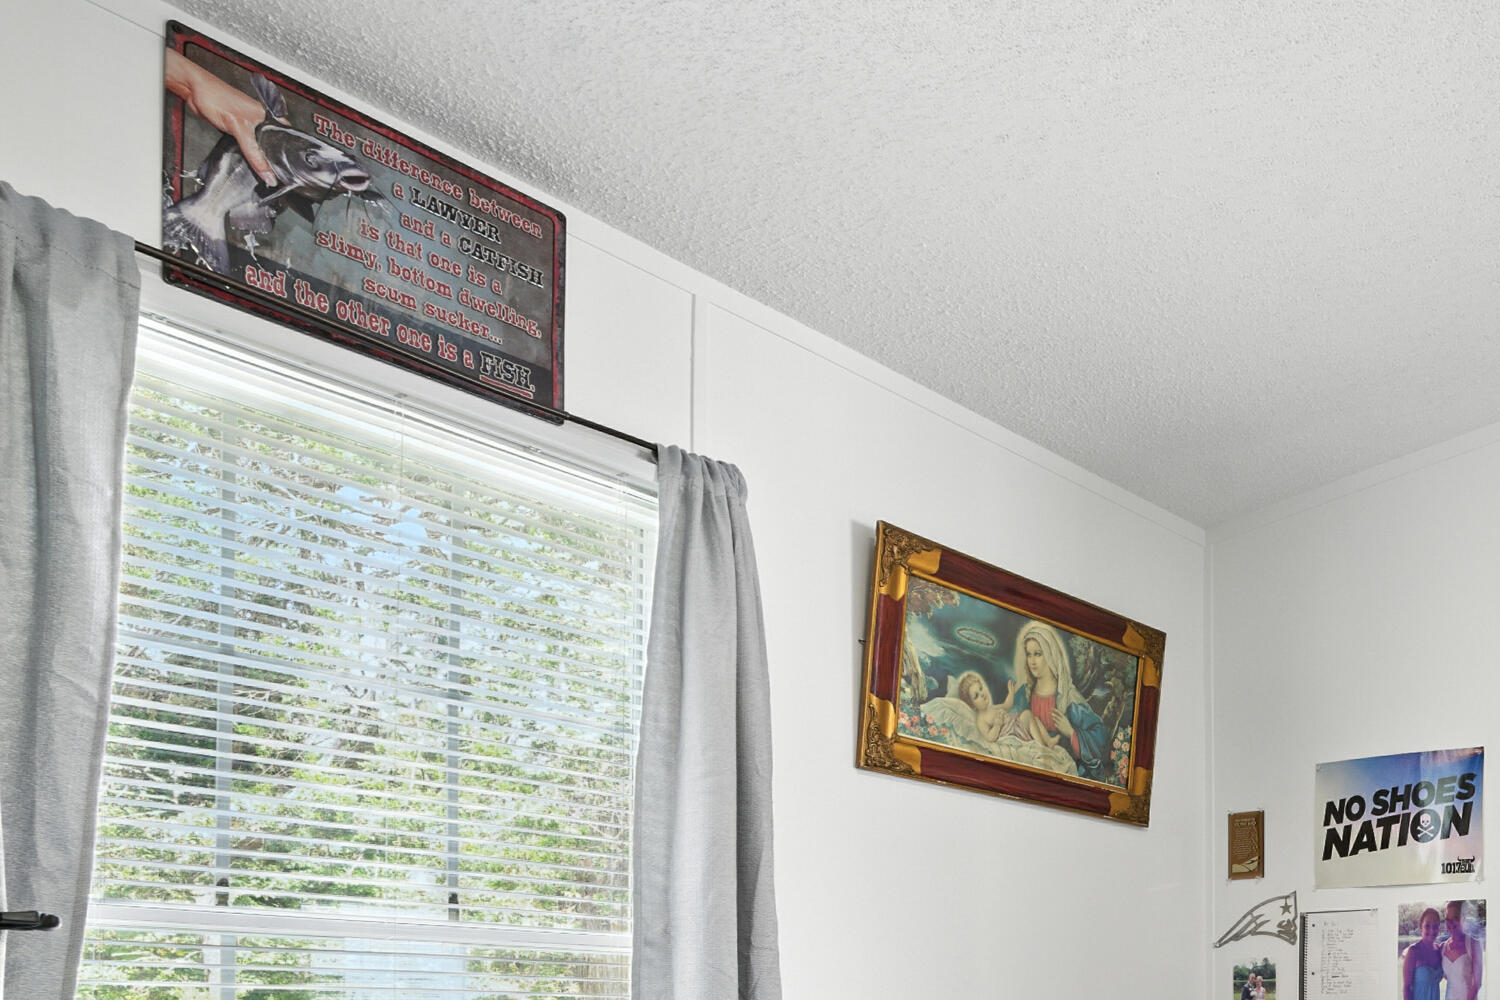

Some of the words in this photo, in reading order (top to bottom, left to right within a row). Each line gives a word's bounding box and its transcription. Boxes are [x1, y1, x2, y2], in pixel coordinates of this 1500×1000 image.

[313, 114, 355, 148] The
[362, 138, 463, 199] difference
[468, 188, 543, 238] between
[393, 182, 404, 199] a
[411, 187, 501, 244] LAWYER
[316, 230, 381, 273] slimy,
[387, 256, 453, 298] bottom
[459, 288, 543, 339] dwelling,
[360, 219, 380, 241] is
[387, 229, 423, 260] that
[428, 246, 462, 276] one
[468, 265, 486, 288] is
[491, 277, 503, 295] a
[400, 212, 436, 240] and
[441, 230, 452, 247] a
[458, 236, 544, 288] CATFISH
[245, 264, 287, 298] and
[293, 279, 330, 315] the
[336, 298, 391, 337] other
[397, 323, 432, 353] one
[437, 333, 457, 362] is
[463, 348, 474, 370] a
[479, 350, 535, 393] FISH.
[364, 277, 417, 311] scum
[424, 301, 503, 345] sucker...
[1322, 801, 1474, 861] NATION
[1323, 795, 1366, 827] NO
[1372, 773, 1477, 816] SHOES
